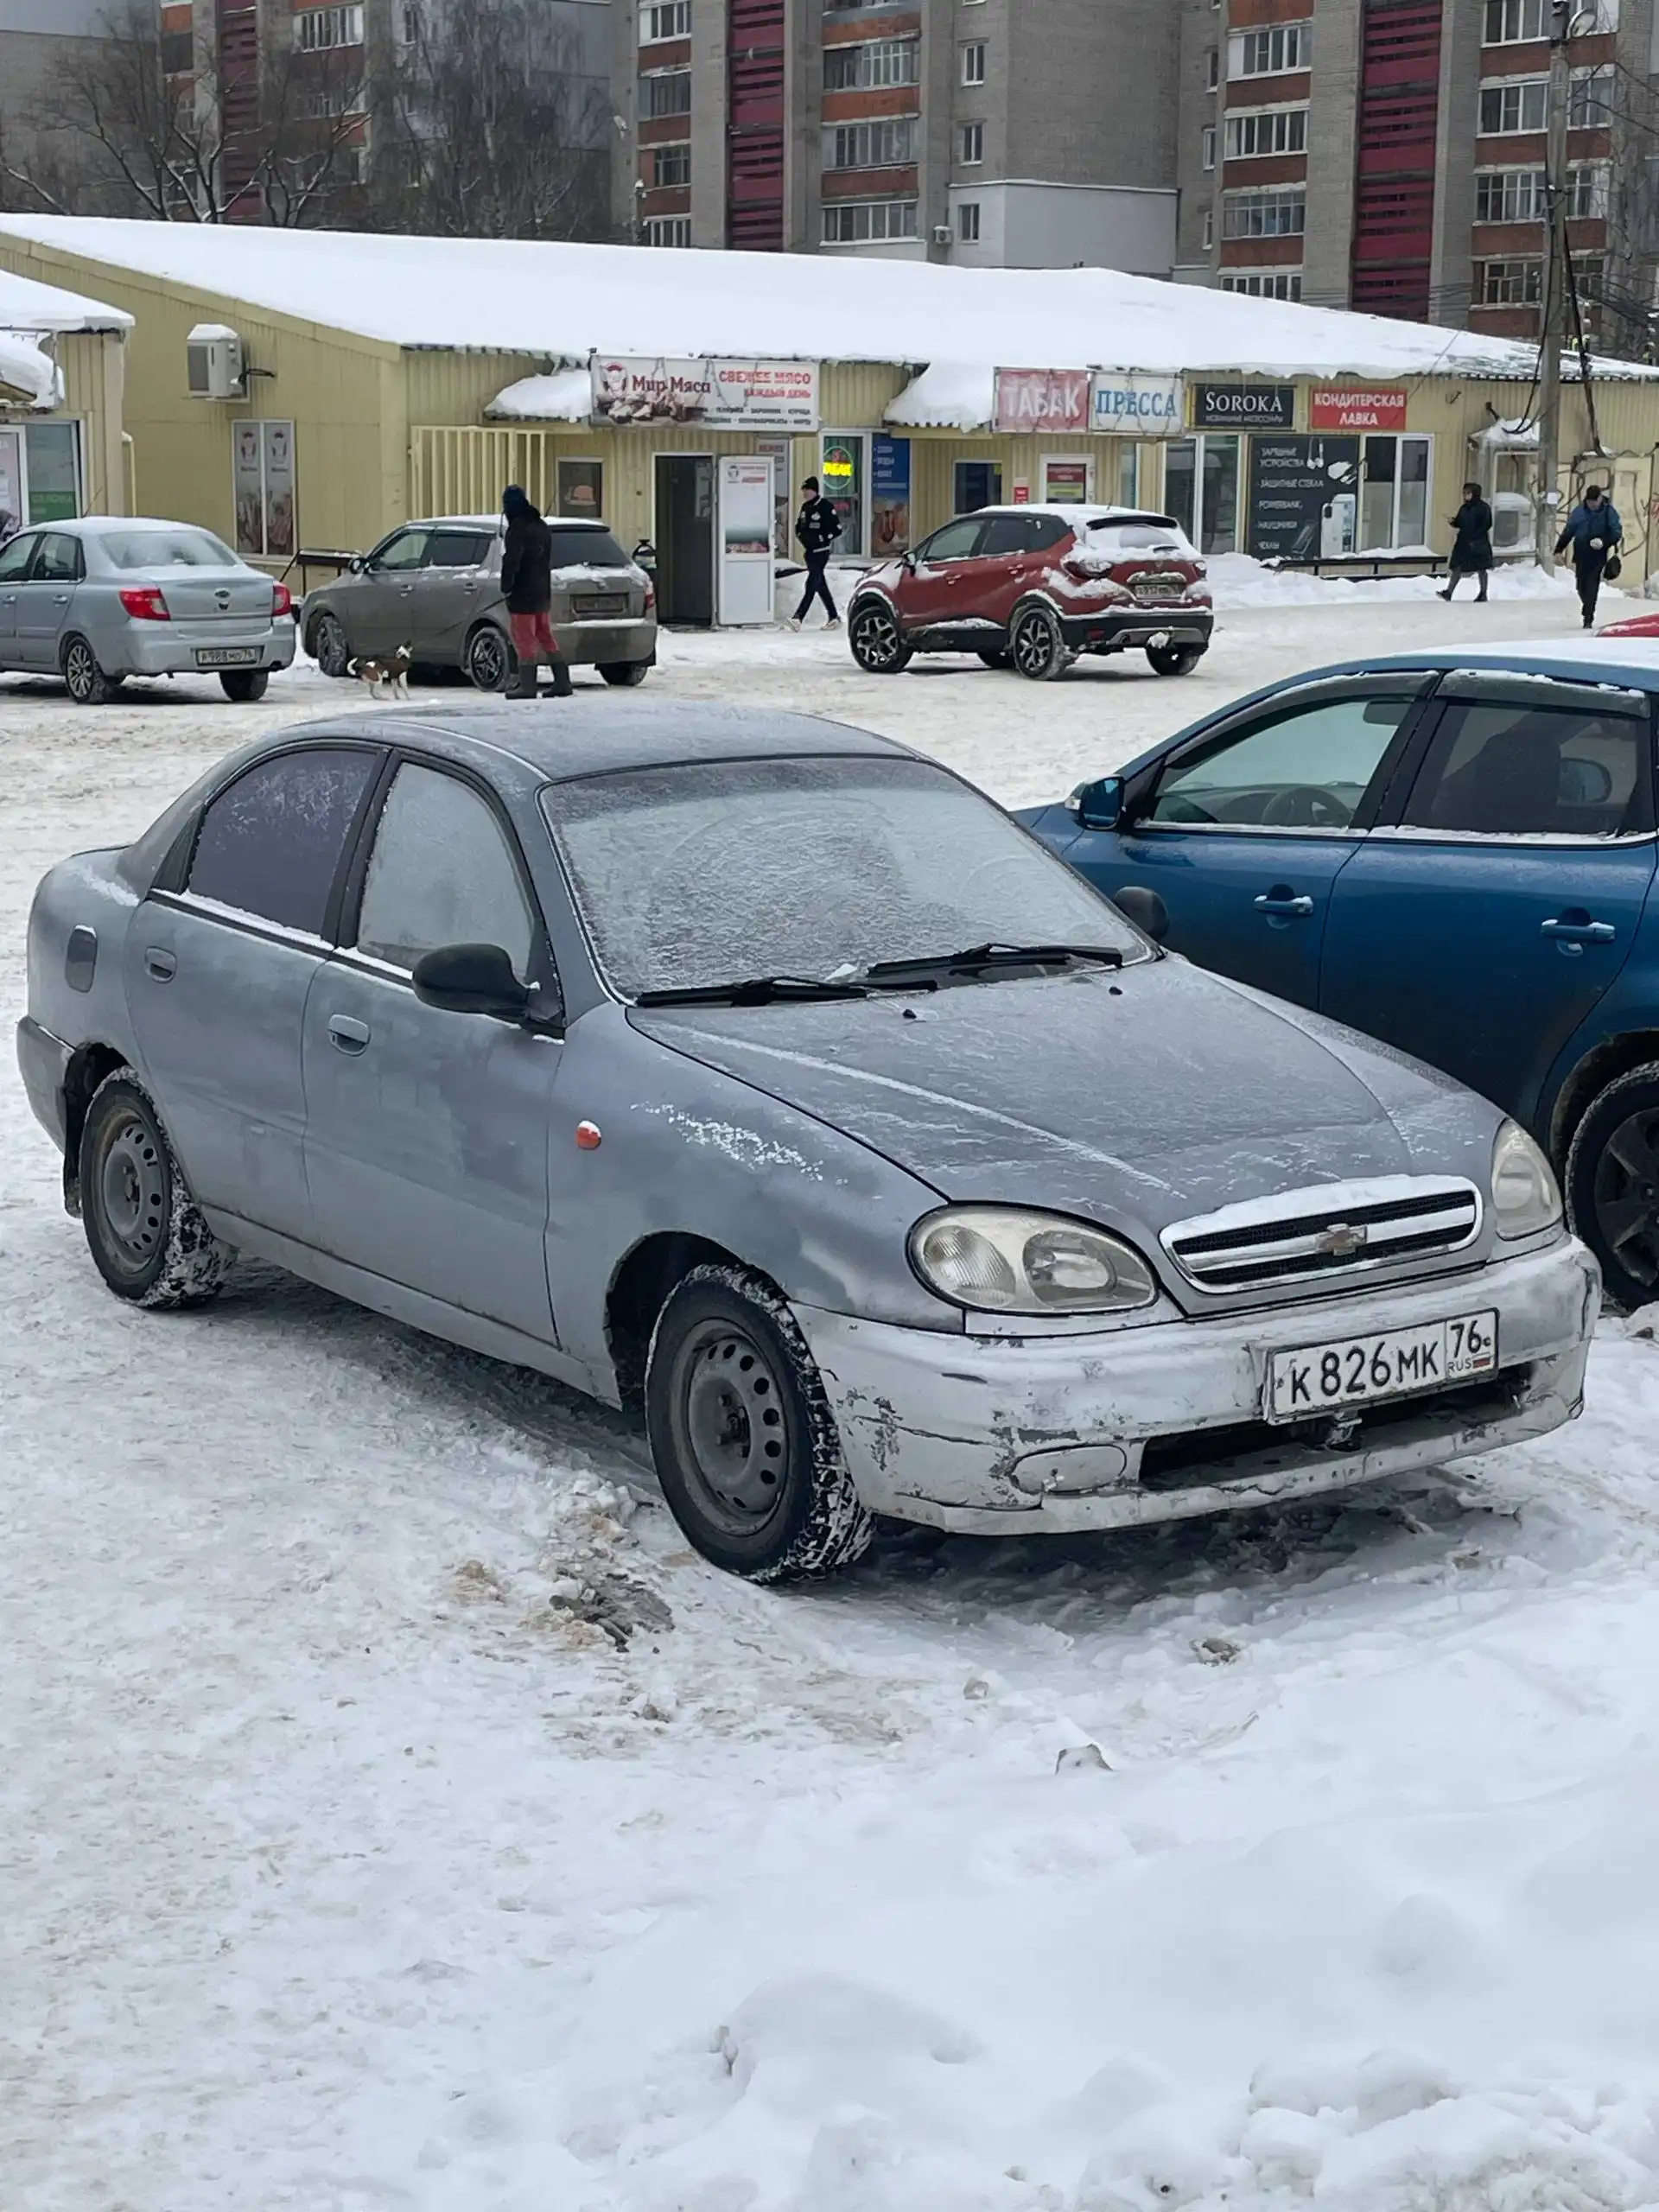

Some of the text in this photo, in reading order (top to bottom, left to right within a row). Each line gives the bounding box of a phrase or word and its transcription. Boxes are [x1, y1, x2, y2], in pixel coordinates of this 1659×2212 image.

[632, 374, 711, 396] Мир Мяса
[719, 370, 811, 385] СВЕЖЕЕ МЯСО
[786, 389, 810, 399] ДЕНЬ
[1004, 386, 1080, 418] ТАБАК
[1096, 390, 1178, 416] ПРЕССА
[1205, 391, 1283, 412] SOROKA
[1314, 393, 1404, 408] КОНДИТЕРСКАЯ
[1339, 412, 1378, 426] ЛАВКА
[1450, 1320, 1481, 1358] 76
[1447, 1357, 1472, 1372] RUS
